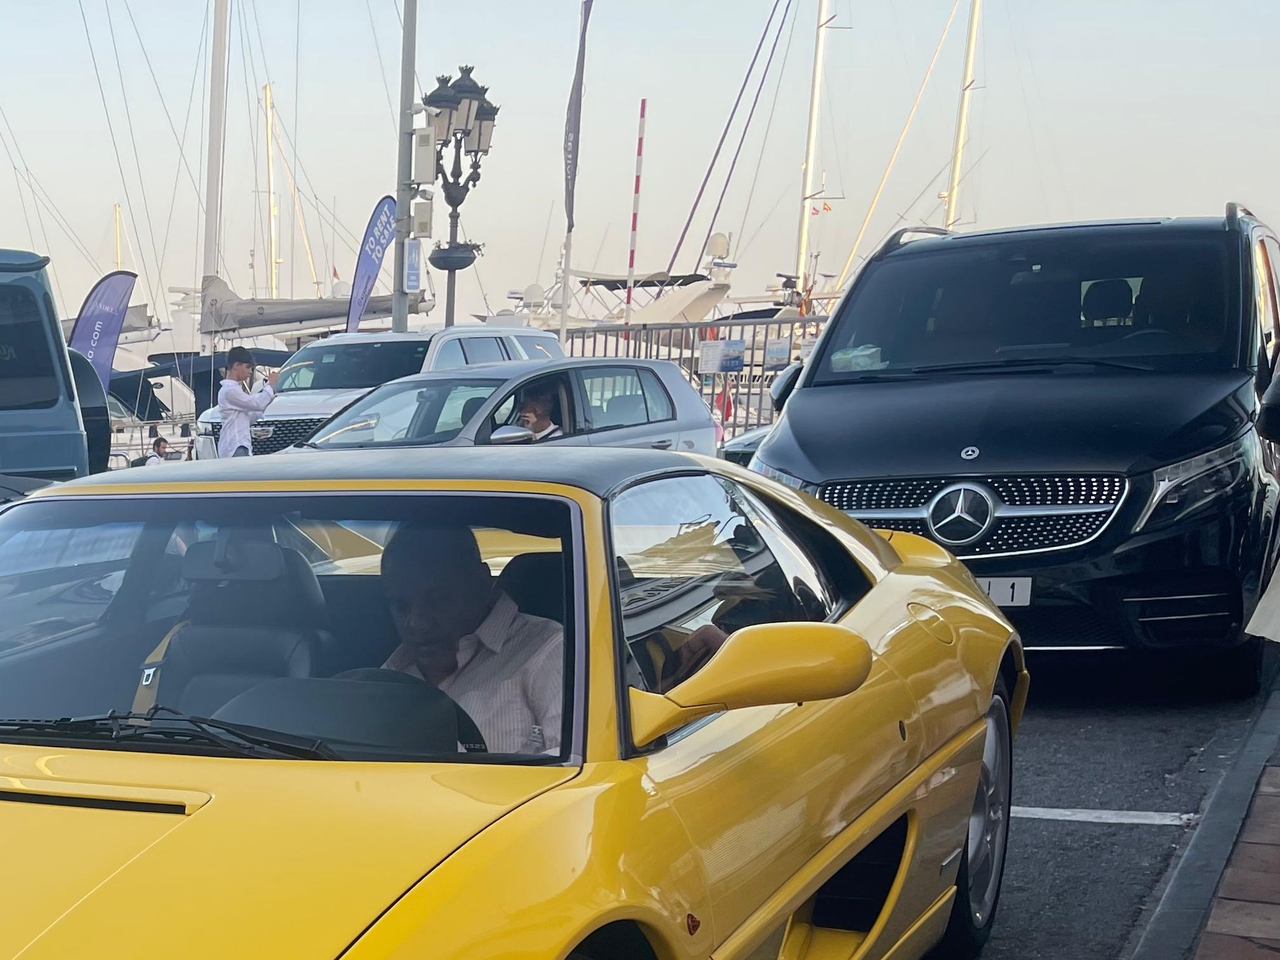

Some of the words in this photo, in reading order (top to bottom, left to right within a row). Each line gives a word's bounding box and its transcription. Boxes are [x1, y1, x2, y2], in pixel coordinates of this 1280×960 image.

[365, 236, 376, 255] TO
[373, 204, 391, 238] RENT
[372, 246, 382, 265] TO
[379, 215, 397, 247] SALE
